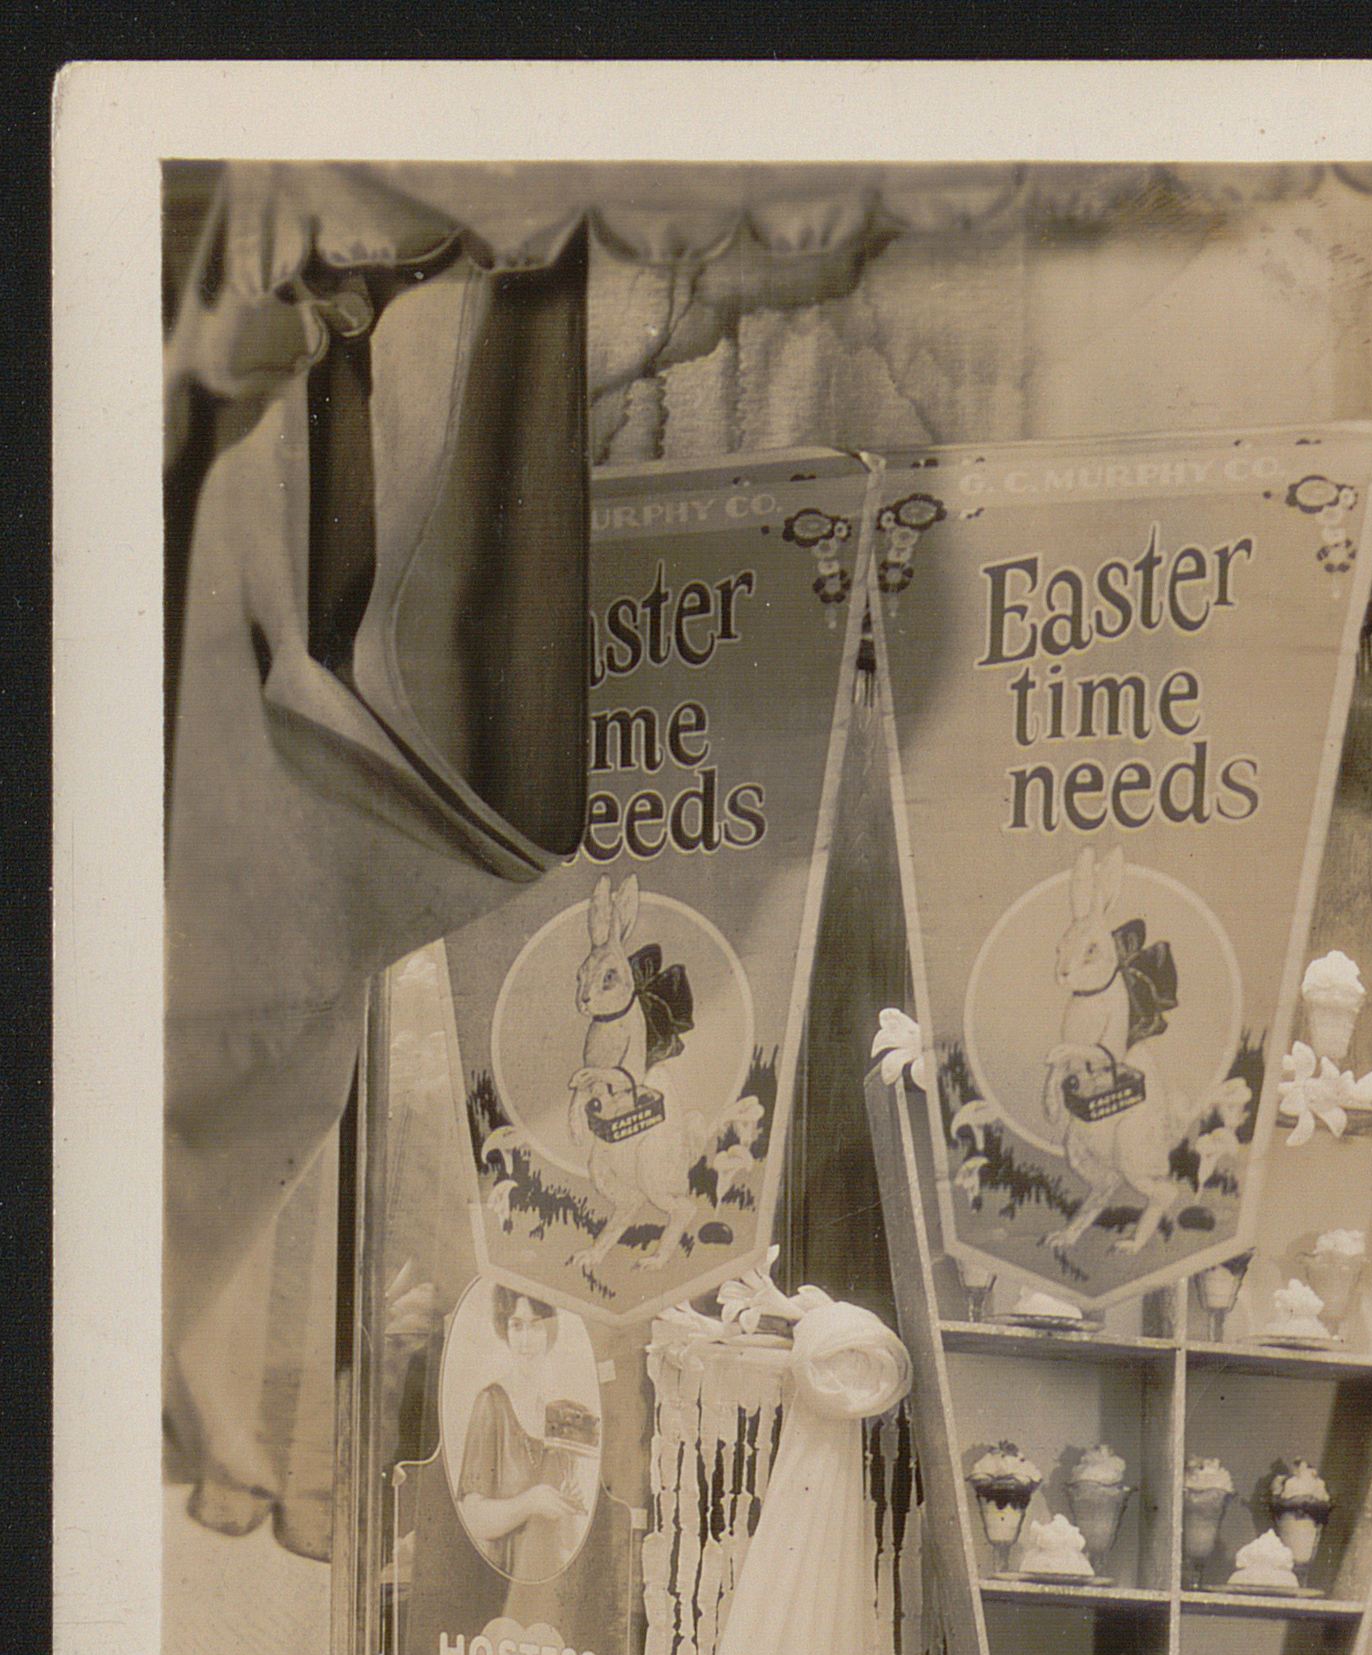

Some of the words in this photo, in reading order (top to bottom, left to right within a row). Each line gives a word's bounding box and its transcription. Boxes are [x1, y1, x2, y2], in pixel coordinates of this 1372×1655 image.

[591, 498, 716, 531] URPHY
[724, 493, 783, 518] CO.
[1042, 458, 1216, 492] MURPHY
[590, 558, 755, 688] ster
[977, 523, 1254, 667] Easter
[590, 699, 710, 775] me
[1010, 664, 1202, 747] time
[564, 766, 768, 866] eeds
[1007, 741, 1260, 832] needs
[610, 1109, 653, 1132] EASTER
